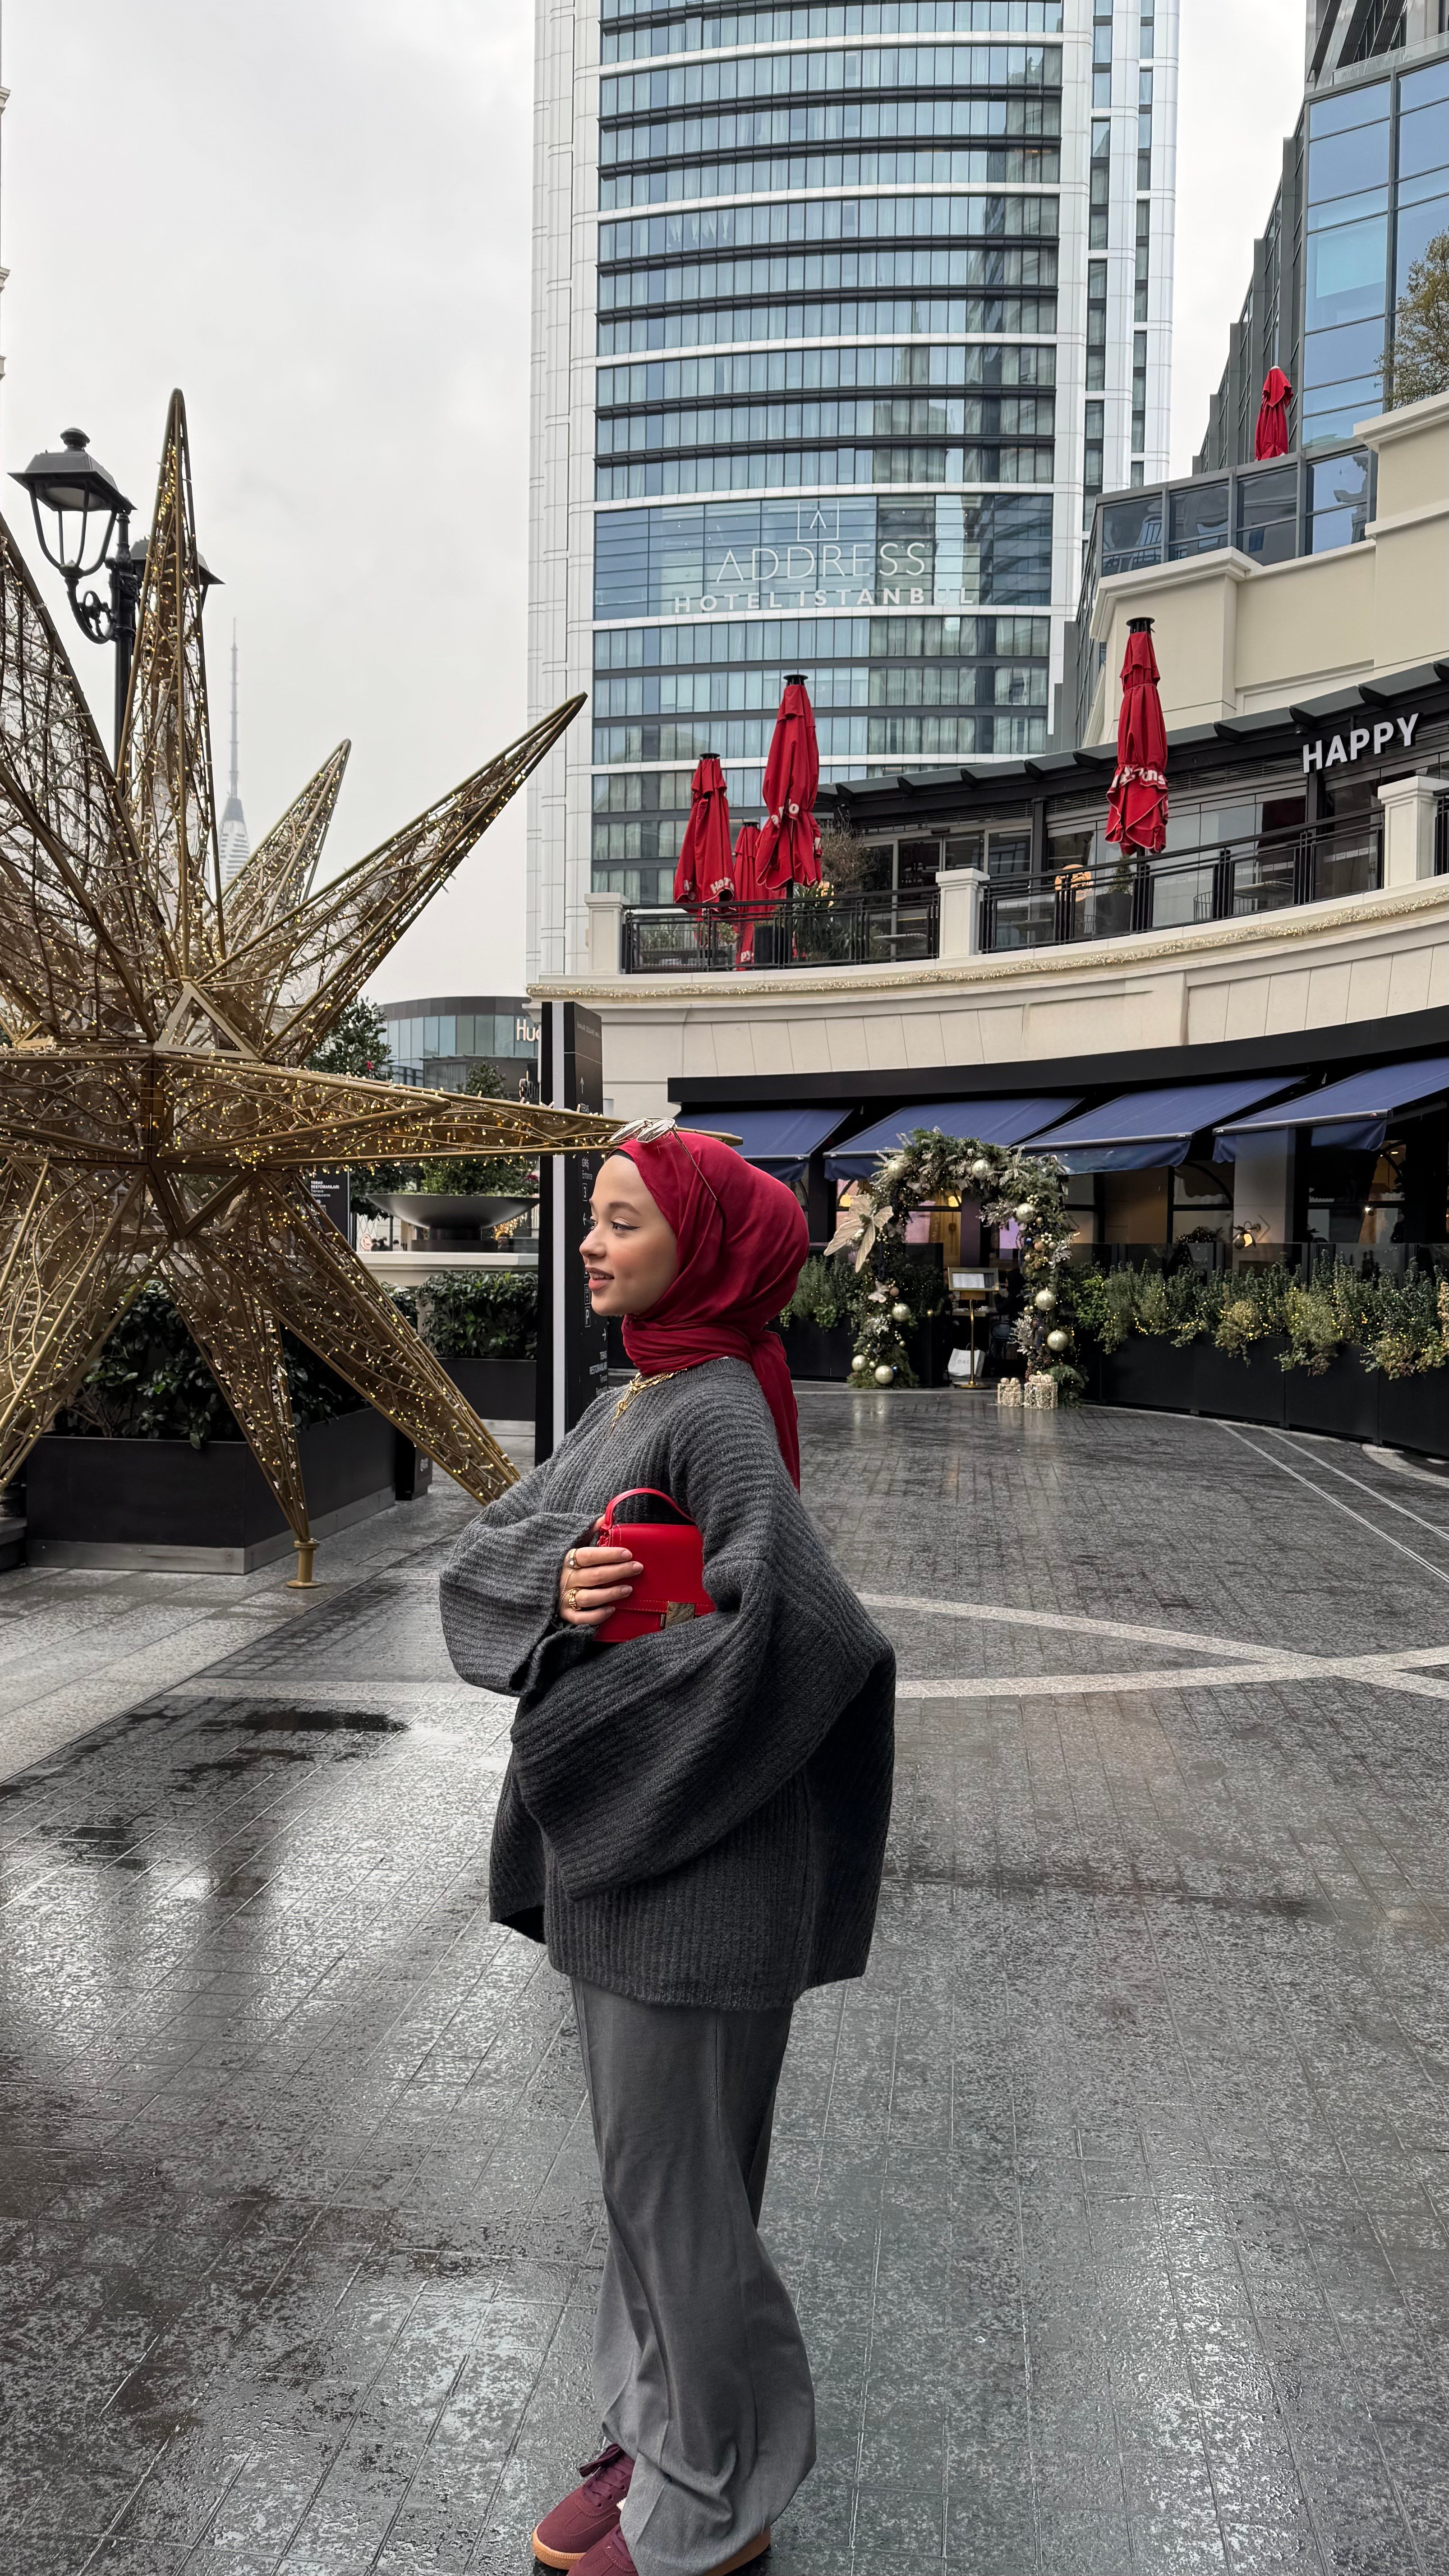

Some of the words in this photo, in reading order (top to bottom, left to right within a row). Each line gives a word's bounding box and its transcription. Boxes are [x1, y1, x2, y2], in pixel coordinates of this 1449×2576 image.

[716, 542, 925, 583] ADDRESS
[675, 591, 782, 613] HOTEL
[800, 587, 973, 607] ISTANBUL
[1302, 713, 1419, 774] HAPPY
